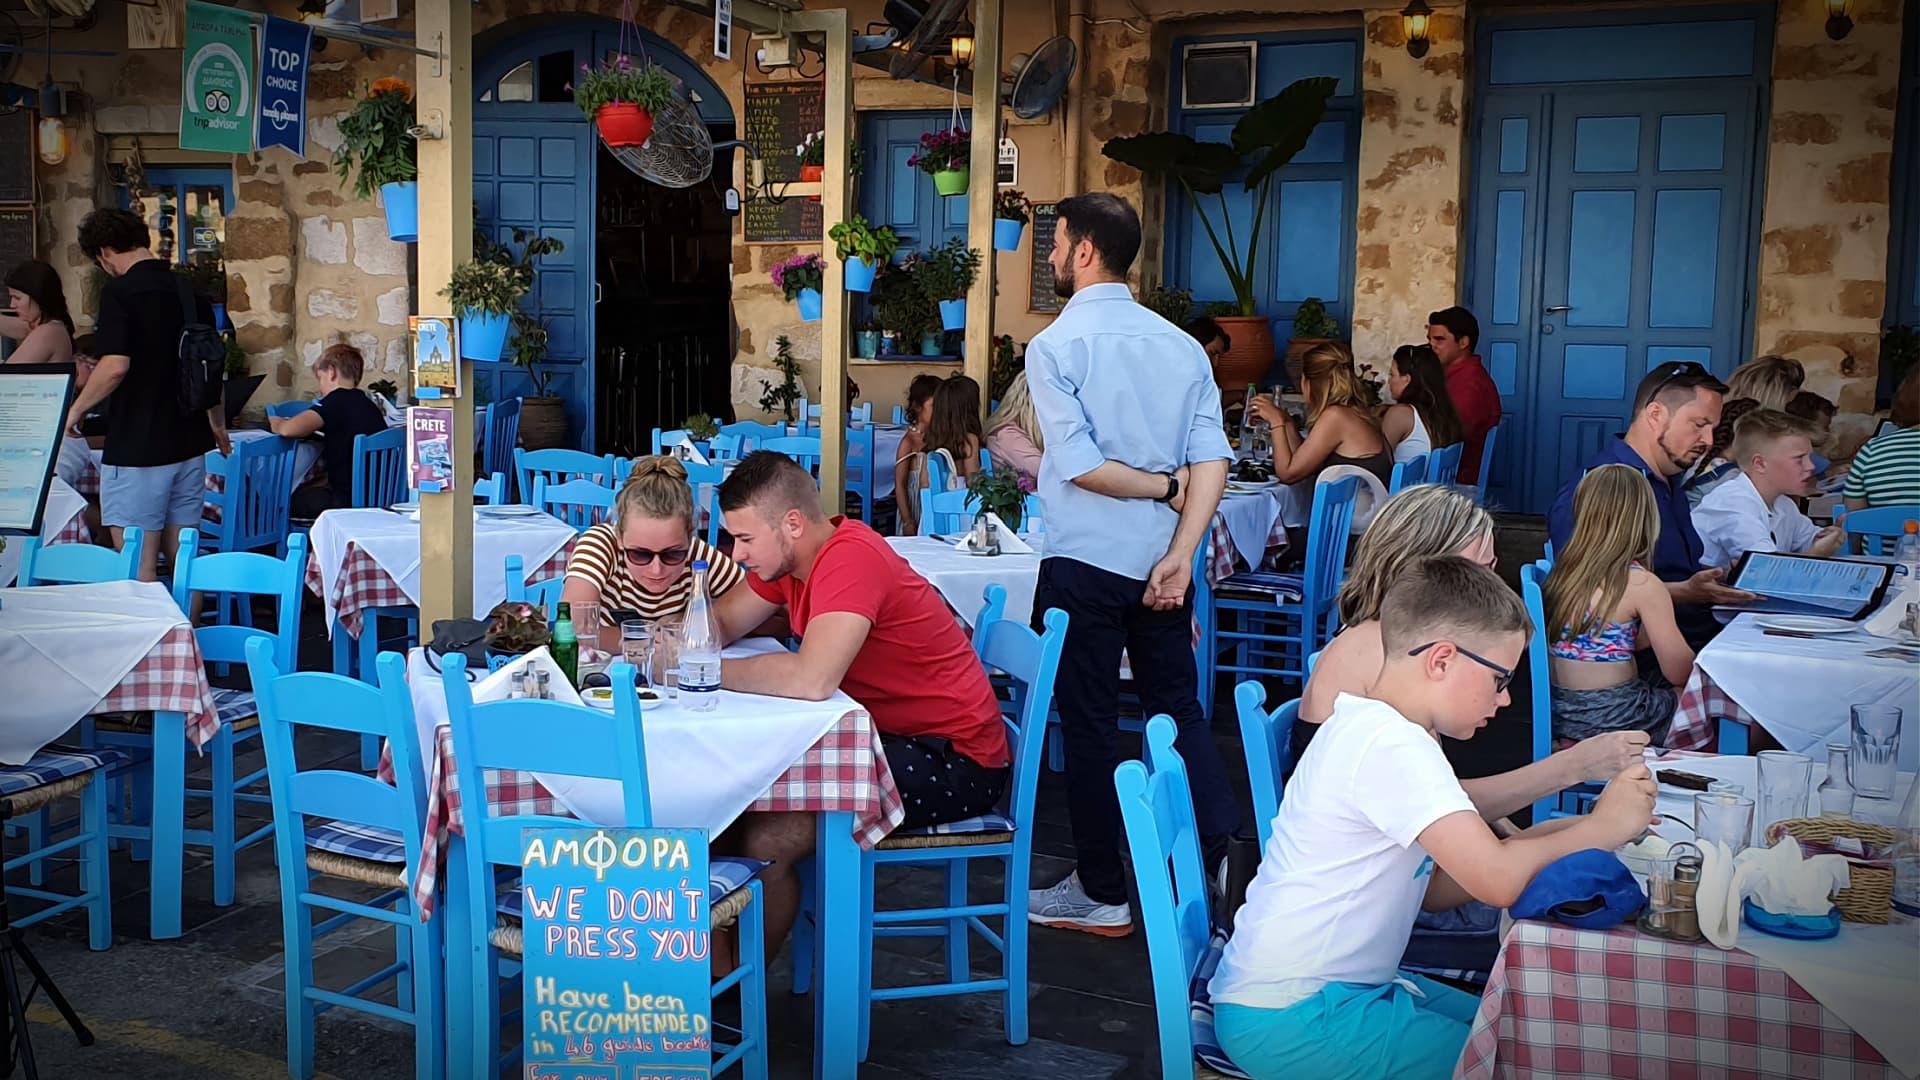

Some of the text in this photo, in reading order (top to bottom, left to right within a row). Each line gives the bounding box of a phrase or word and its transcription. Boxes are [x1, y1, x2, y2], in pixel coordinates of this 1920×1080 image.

[269, 48, 300, 72] TOP
[266, 75, 299, 92] CHOICE
[193, 115, 240, 130] tripadvisor
[1035, 204, 1058, 215] GRE
[418, 323, 437, 332] CRETE
[414, 418, 446, 432] CRETE
[524, 830, 690, 881] ΑΜΦΟΡΑ
[525, 885, 587, 921] WE
[545, 925, 710, 961] PRESS YOU
[534, 975, 685, 1012] Have been
[539, 1010, 710, 1034] RECOMMENDED
[530, 1032, 555, 1056] in
[565, 1033, 596, 1057] 46
[601, 1037, 654, 1063] guide
